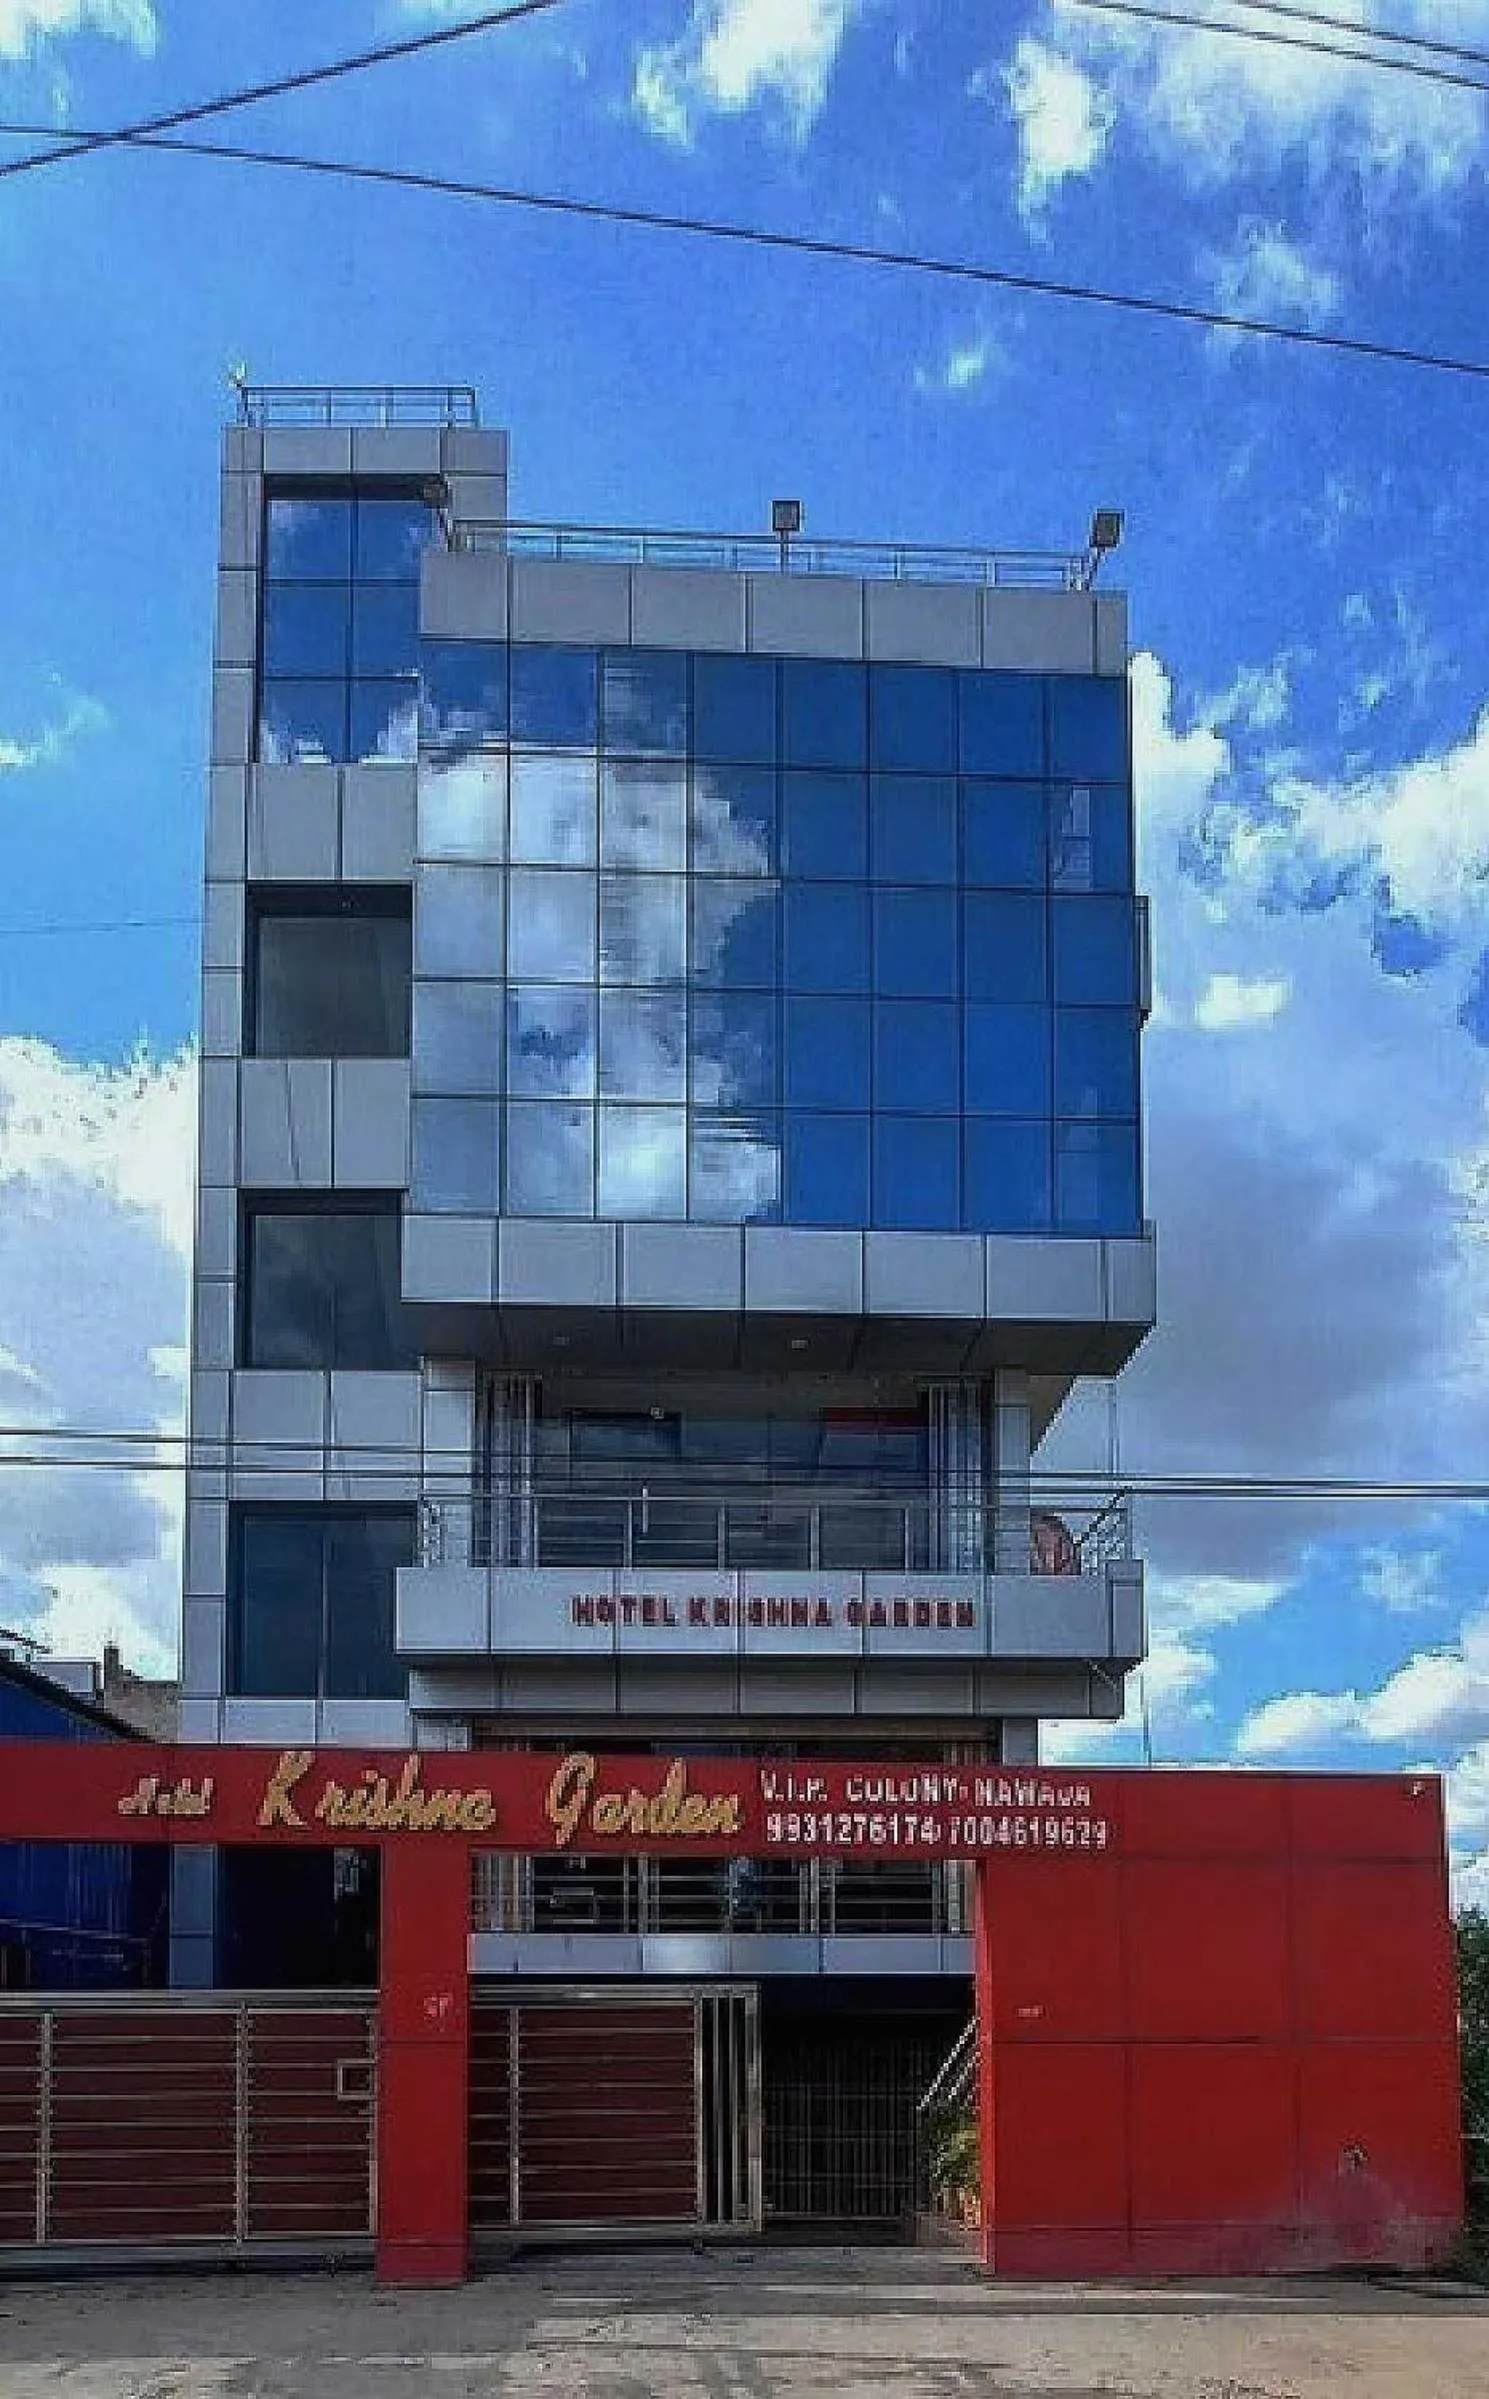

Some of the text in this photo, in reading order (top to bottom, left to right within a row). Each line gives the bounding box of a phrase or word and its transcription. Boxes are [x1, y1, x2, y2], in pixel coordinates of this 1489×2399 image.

[572, 1594, 976, 1630] HOTEL KRISHNA GARDEN
[256, 1751, 496, 1830] Krishna
[546, 1753, 744, 1848] Garden
[760, 1770, 828, 1802] V.I.P.
